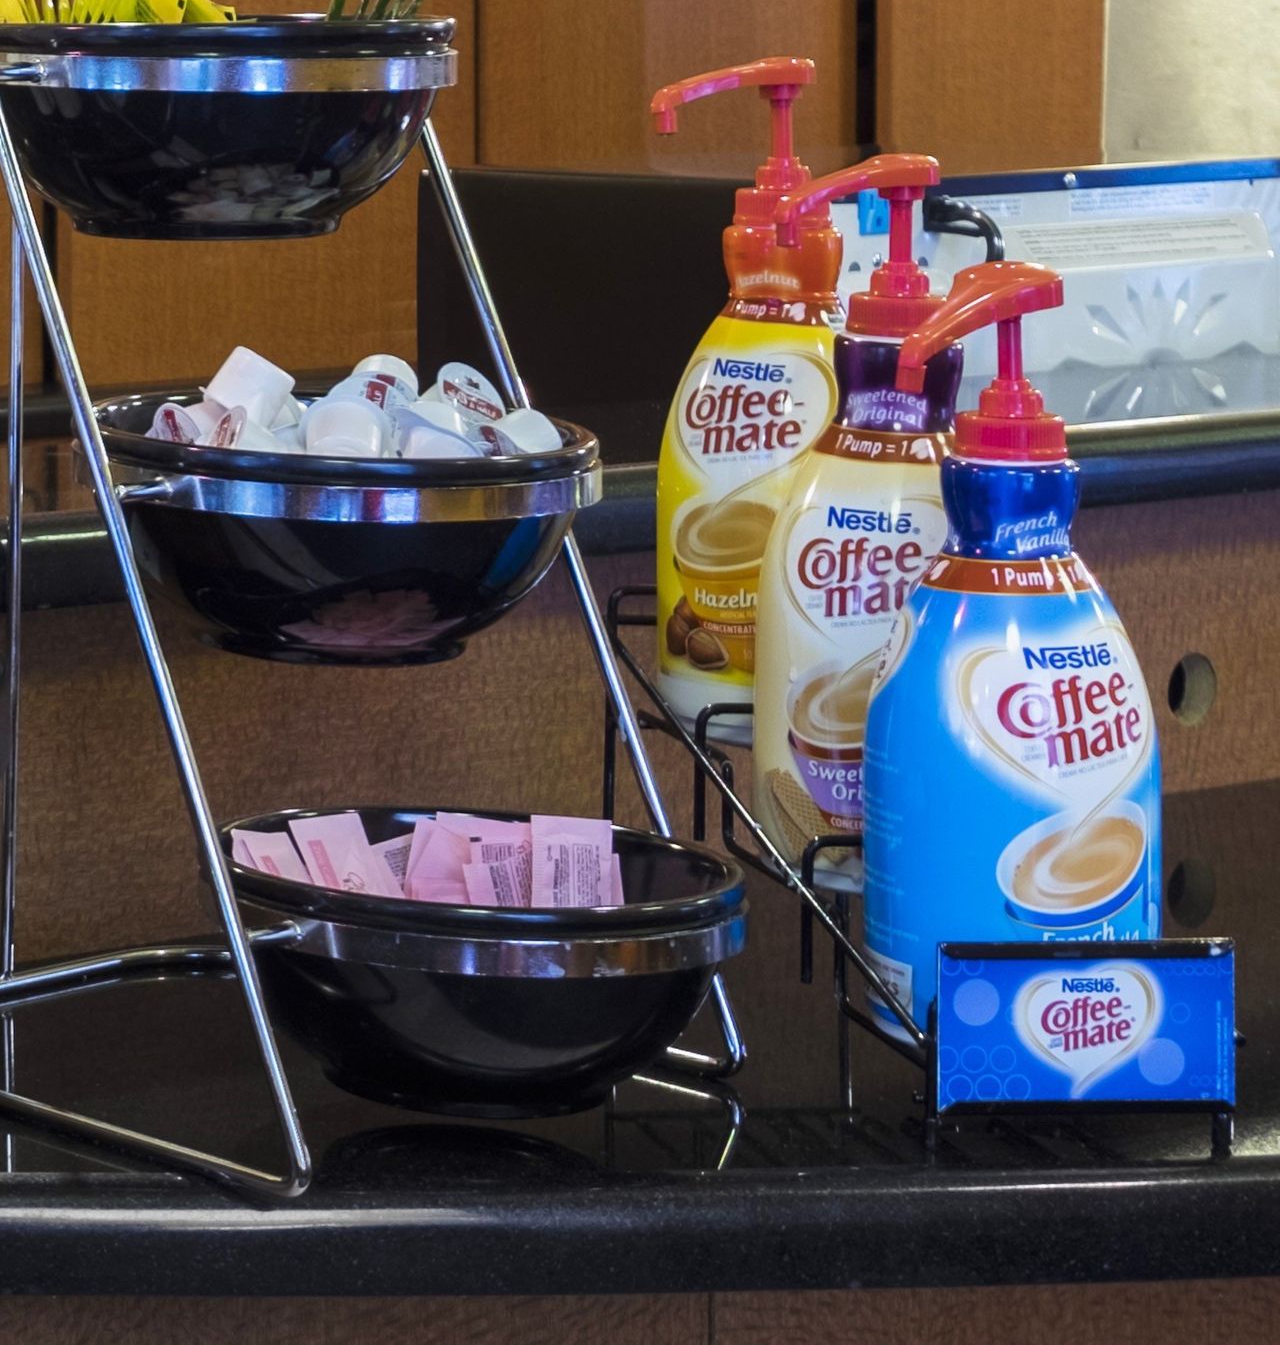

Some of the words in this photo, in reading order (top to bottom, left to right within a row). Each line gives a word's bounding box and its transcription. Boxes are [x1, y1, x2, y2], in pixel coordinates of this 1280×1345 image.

[847, 389, 927, 414] Sweetened
[852, 406, 924, 429] Original
[702, 419, 802, 454] mate
[843, 434, 882, 458] Pump
[995, 510, 1058, 542] French
[1016, 528, 1070, 554] Vanilla
[991, 567, 999, 586] 1
[824, 576, 910, 617] mat
[1044, 707, 1142, 768] mate
[1063, 1019, 1132, 1052] mate
